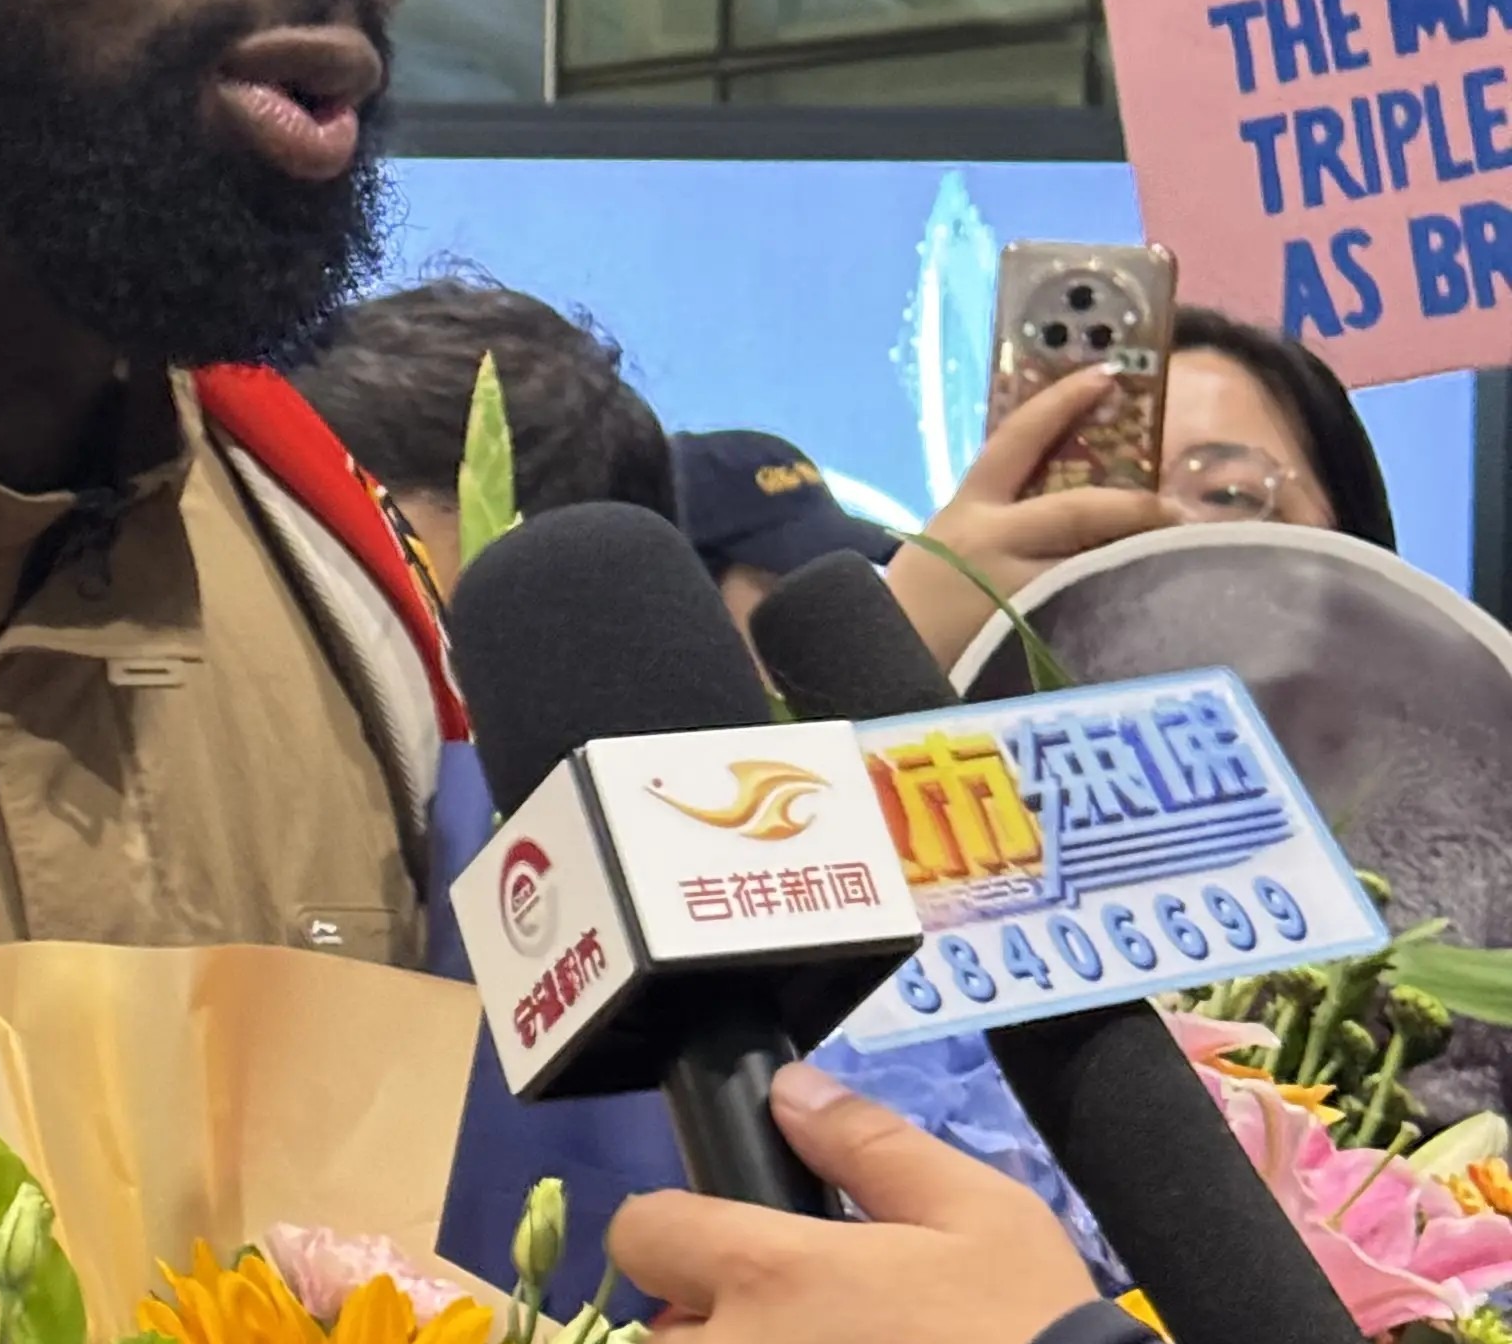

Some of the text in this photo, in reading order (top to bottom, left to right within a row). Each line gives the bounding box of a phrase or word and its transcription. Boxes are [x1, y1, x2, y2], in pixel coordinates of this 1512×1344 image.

[1240, 66, 1512, 215] TRIPLE
[1282, 200, 1512, 342] AS BR
[679, 862, 880, 921] 吉祥新闻
